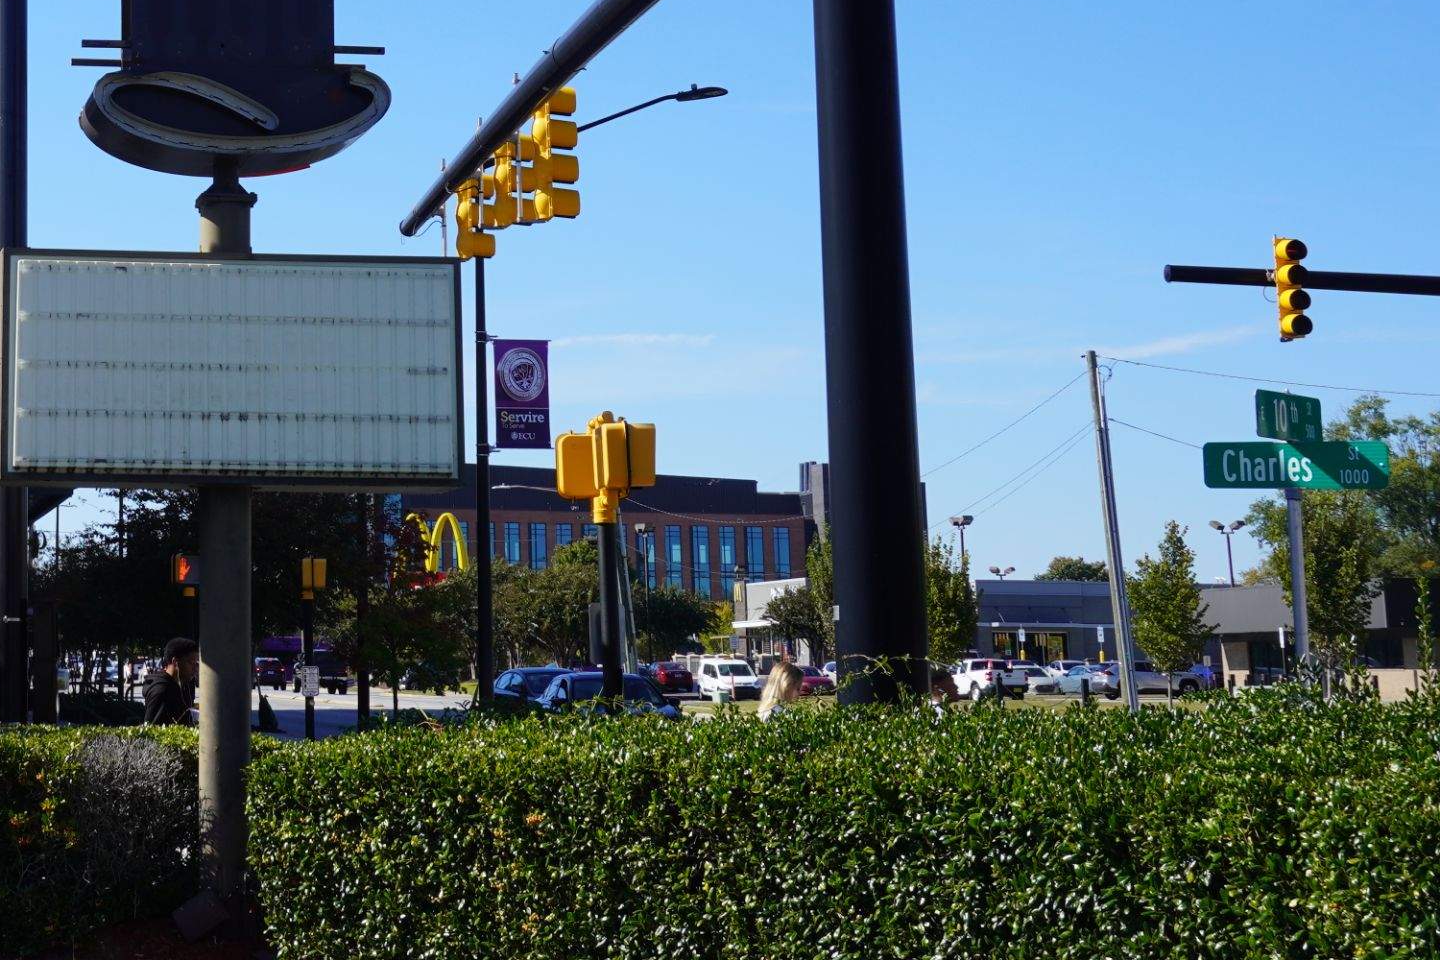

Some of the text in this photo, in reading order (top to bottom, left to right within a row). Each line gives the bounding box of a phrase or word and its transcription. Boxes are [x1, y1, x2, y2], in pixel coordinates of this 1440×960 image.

[500, 410, 545, 423] Servire
[518, 432, 536, 440] ECU
[1222, 445, 1360, 482] Charles St
[1339, 469, 1369, 484] 1000
